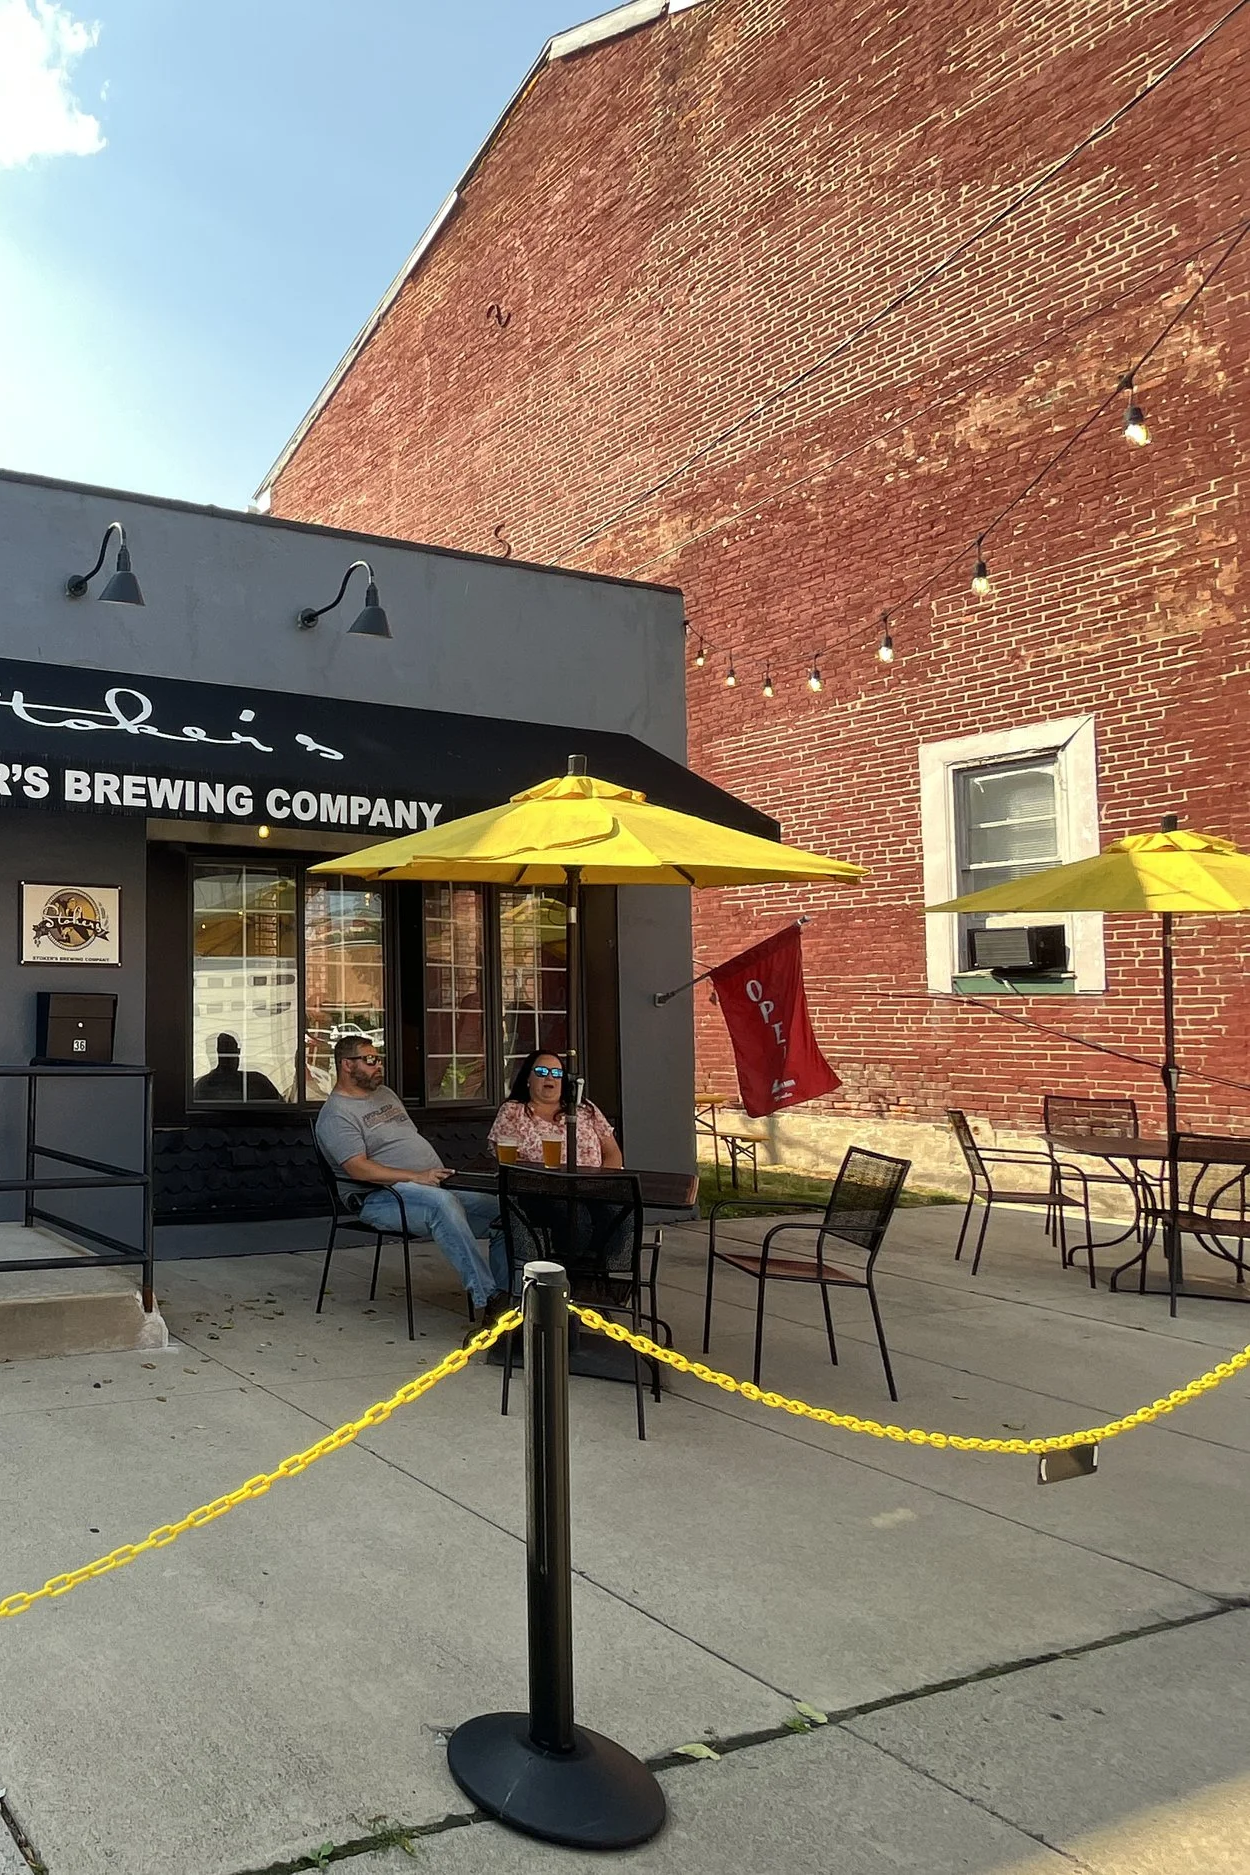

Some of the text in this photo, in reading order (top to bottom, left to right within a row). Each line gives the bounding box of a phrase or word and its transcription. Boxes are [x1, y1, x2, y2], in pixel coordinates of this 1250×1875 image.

[64, 769, 254, 816] BREWING
[266, 788, 443, 830] COMPANY
[74, 1040, 86, 1051] 36
[745, 980, 788, 1059] OPE
